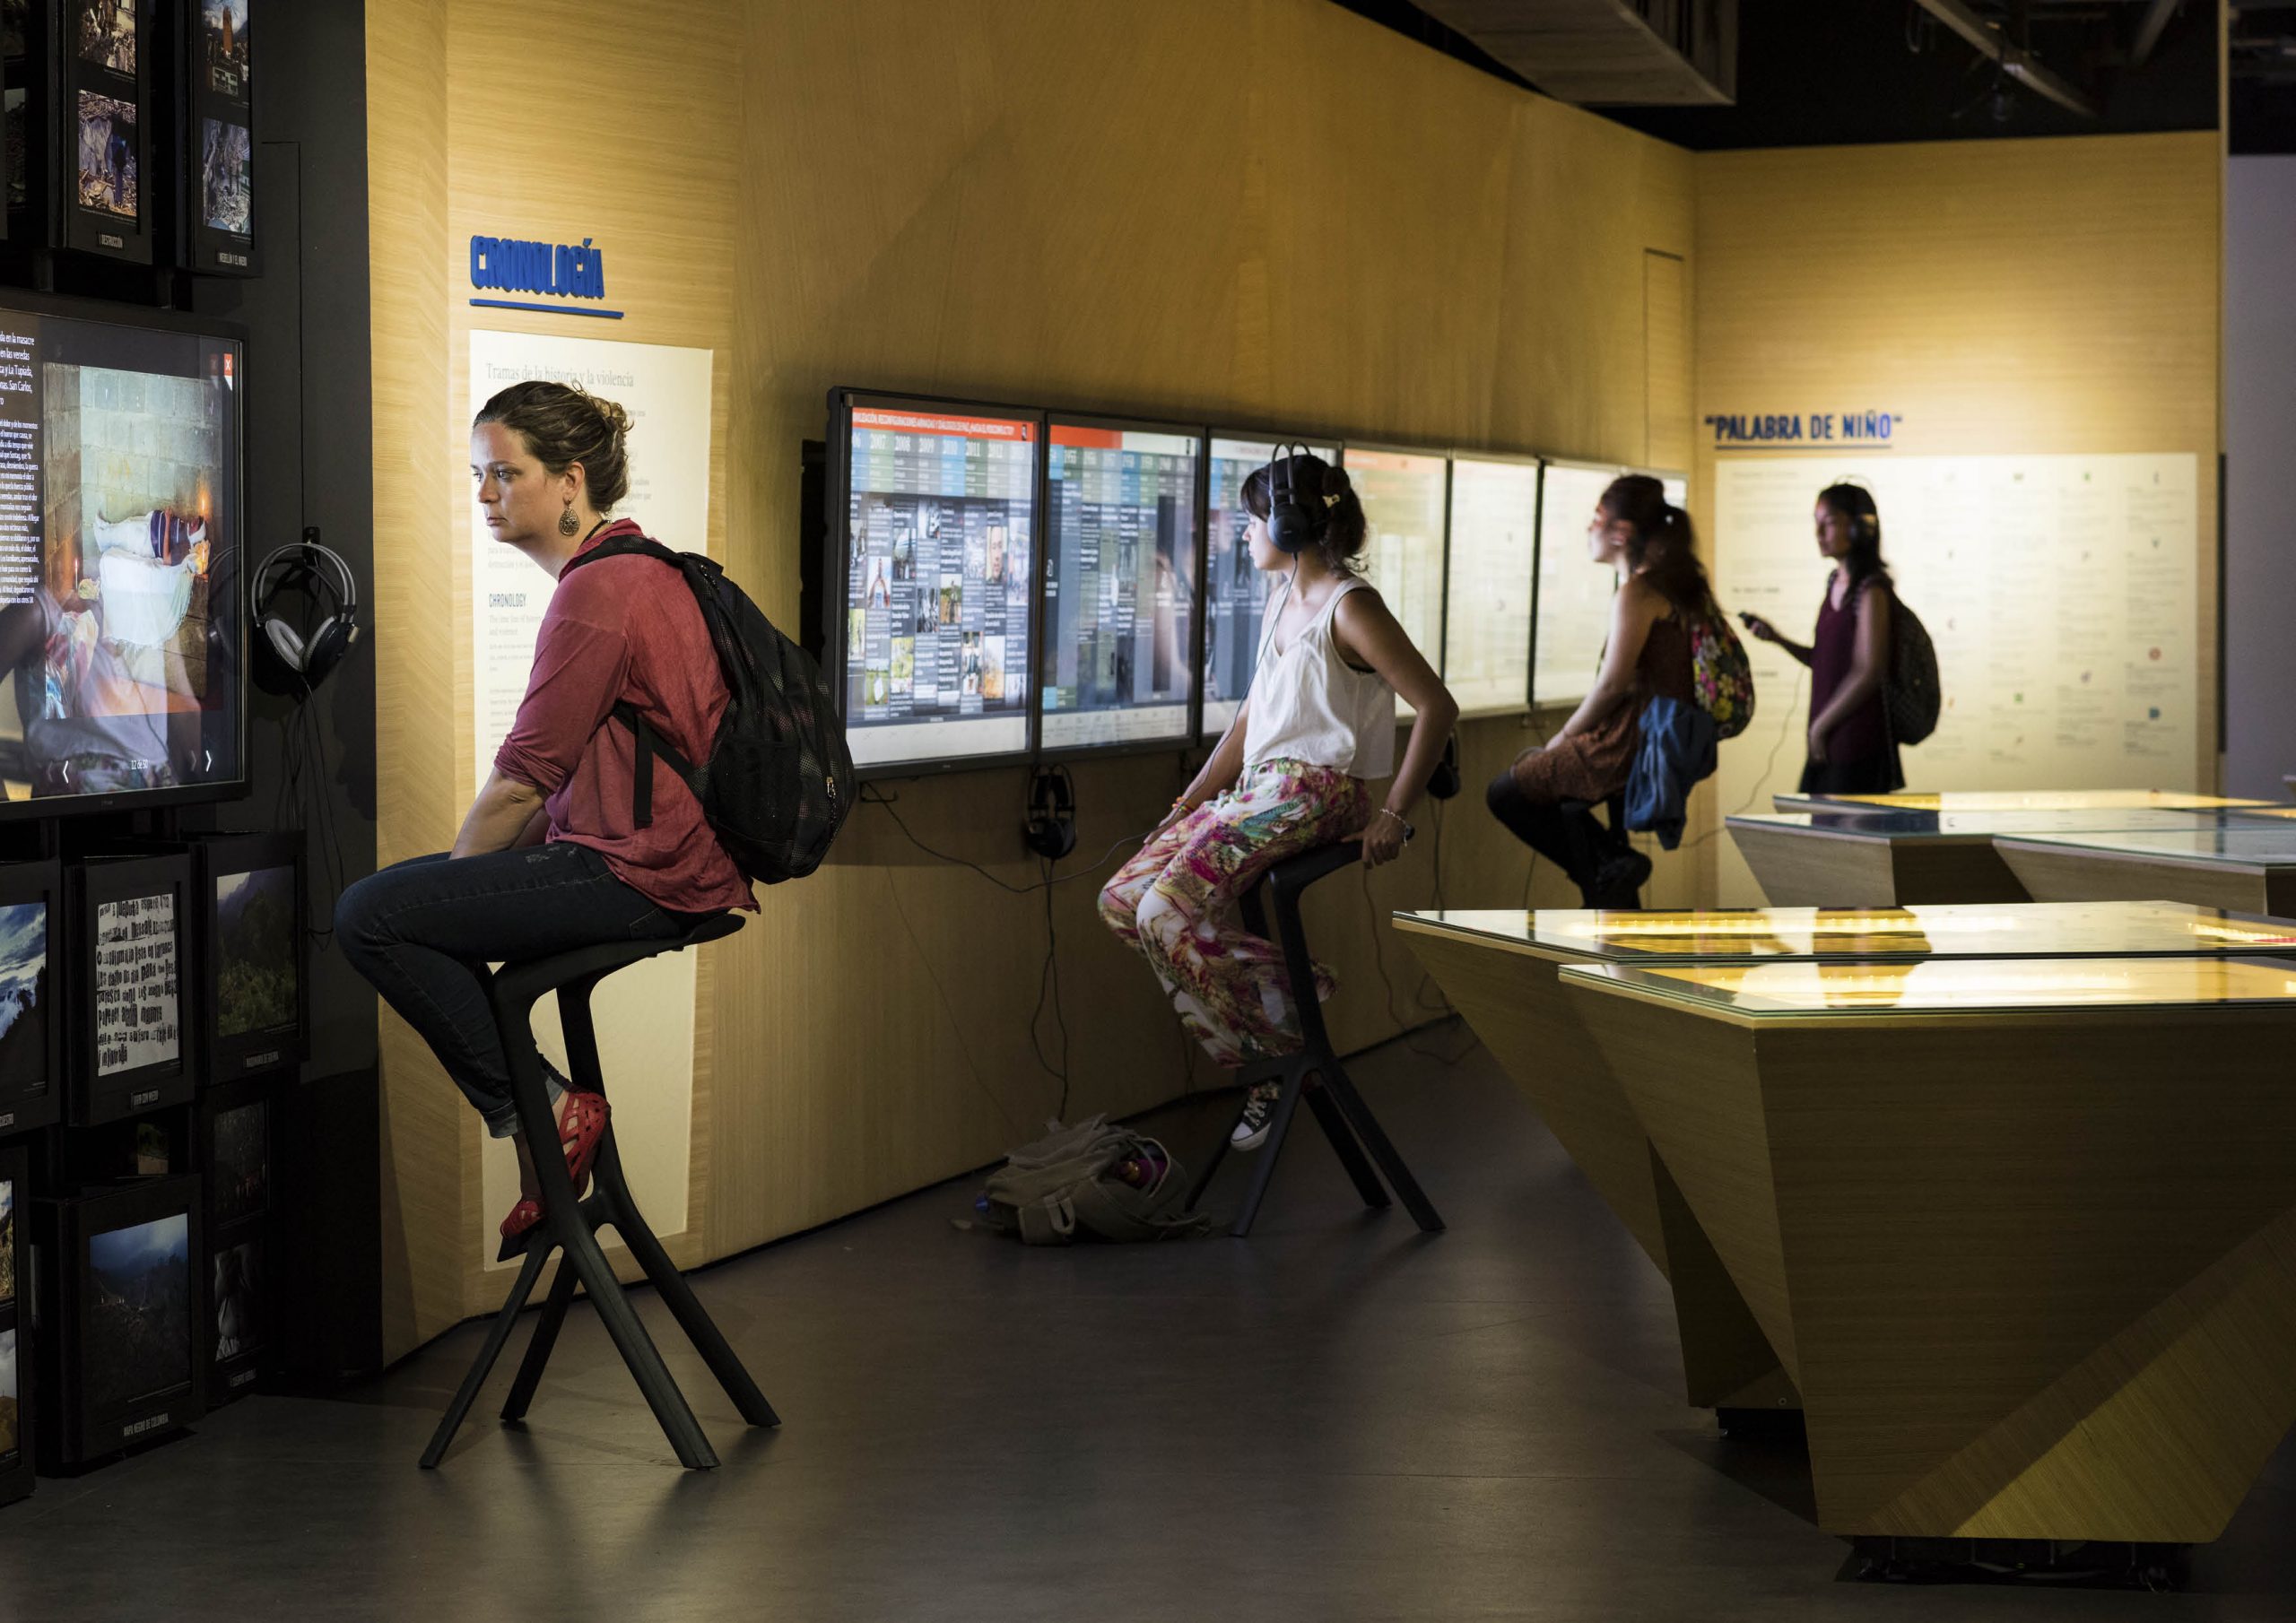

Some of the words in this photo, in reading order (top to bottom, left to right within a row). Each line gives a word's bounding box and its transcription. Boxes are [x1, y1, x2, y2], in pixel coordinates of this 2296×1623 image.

[471, 235, 604, 299] CRONOLOGÍA
[17, 335, 34, 345] masacre
[9, 380, 17, 391] San
[486, 363, 519, 380] Tramas
[521, 364, 533, 381] de
[535, 365, 543, 381] la
[587, 369, 595, 385] la
[596, 367, 634, 387] violencia
[1810, 415, 1834, 439] DE
[489, 593, 526, 608] CHRONOLOGY
[134, 1420, 145, 1434] NEGRO
[145, 1418, 152, 1430] DE
[152, 1412, 169, 1428] COLOMBIA
